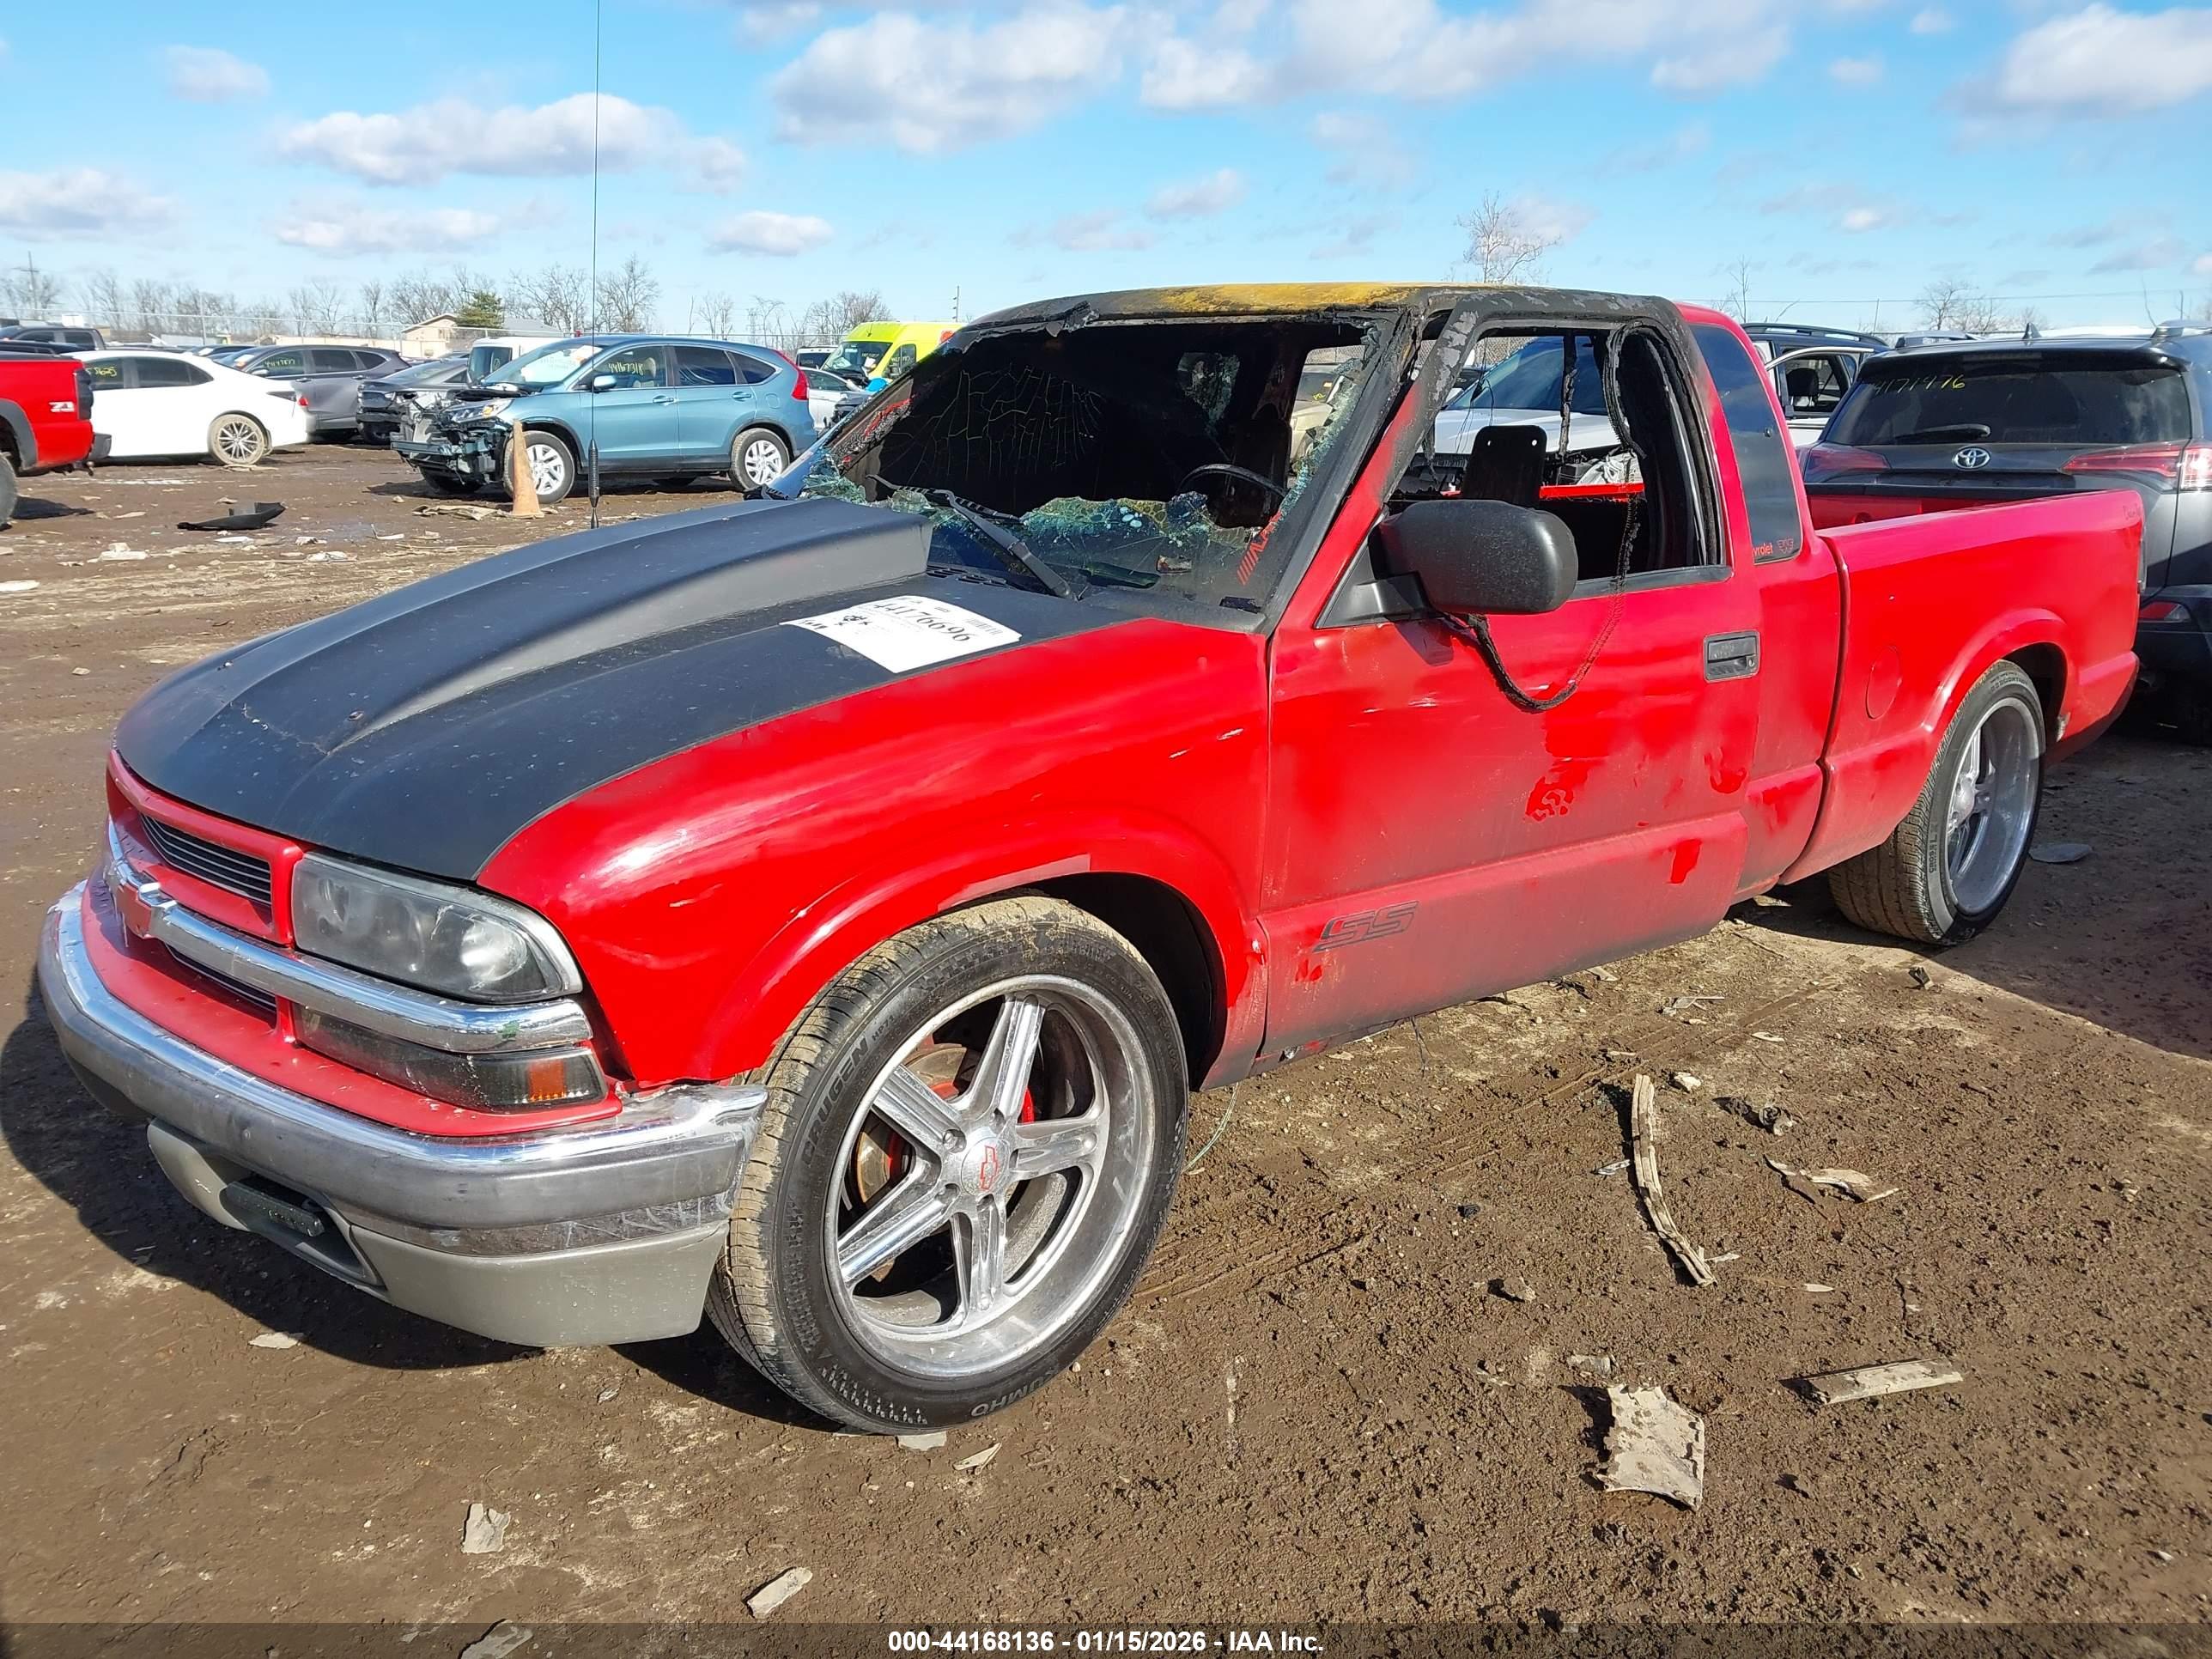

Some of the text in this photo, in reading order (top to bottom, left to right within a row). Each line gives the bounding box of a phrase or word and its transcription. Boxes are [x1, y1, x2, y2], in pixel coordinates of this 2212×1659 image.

[873, 603, 975, 641] 44176696
[1311, 900, 1419, 953] SS
[801, 1036, 870, 1165] CRUGEN
